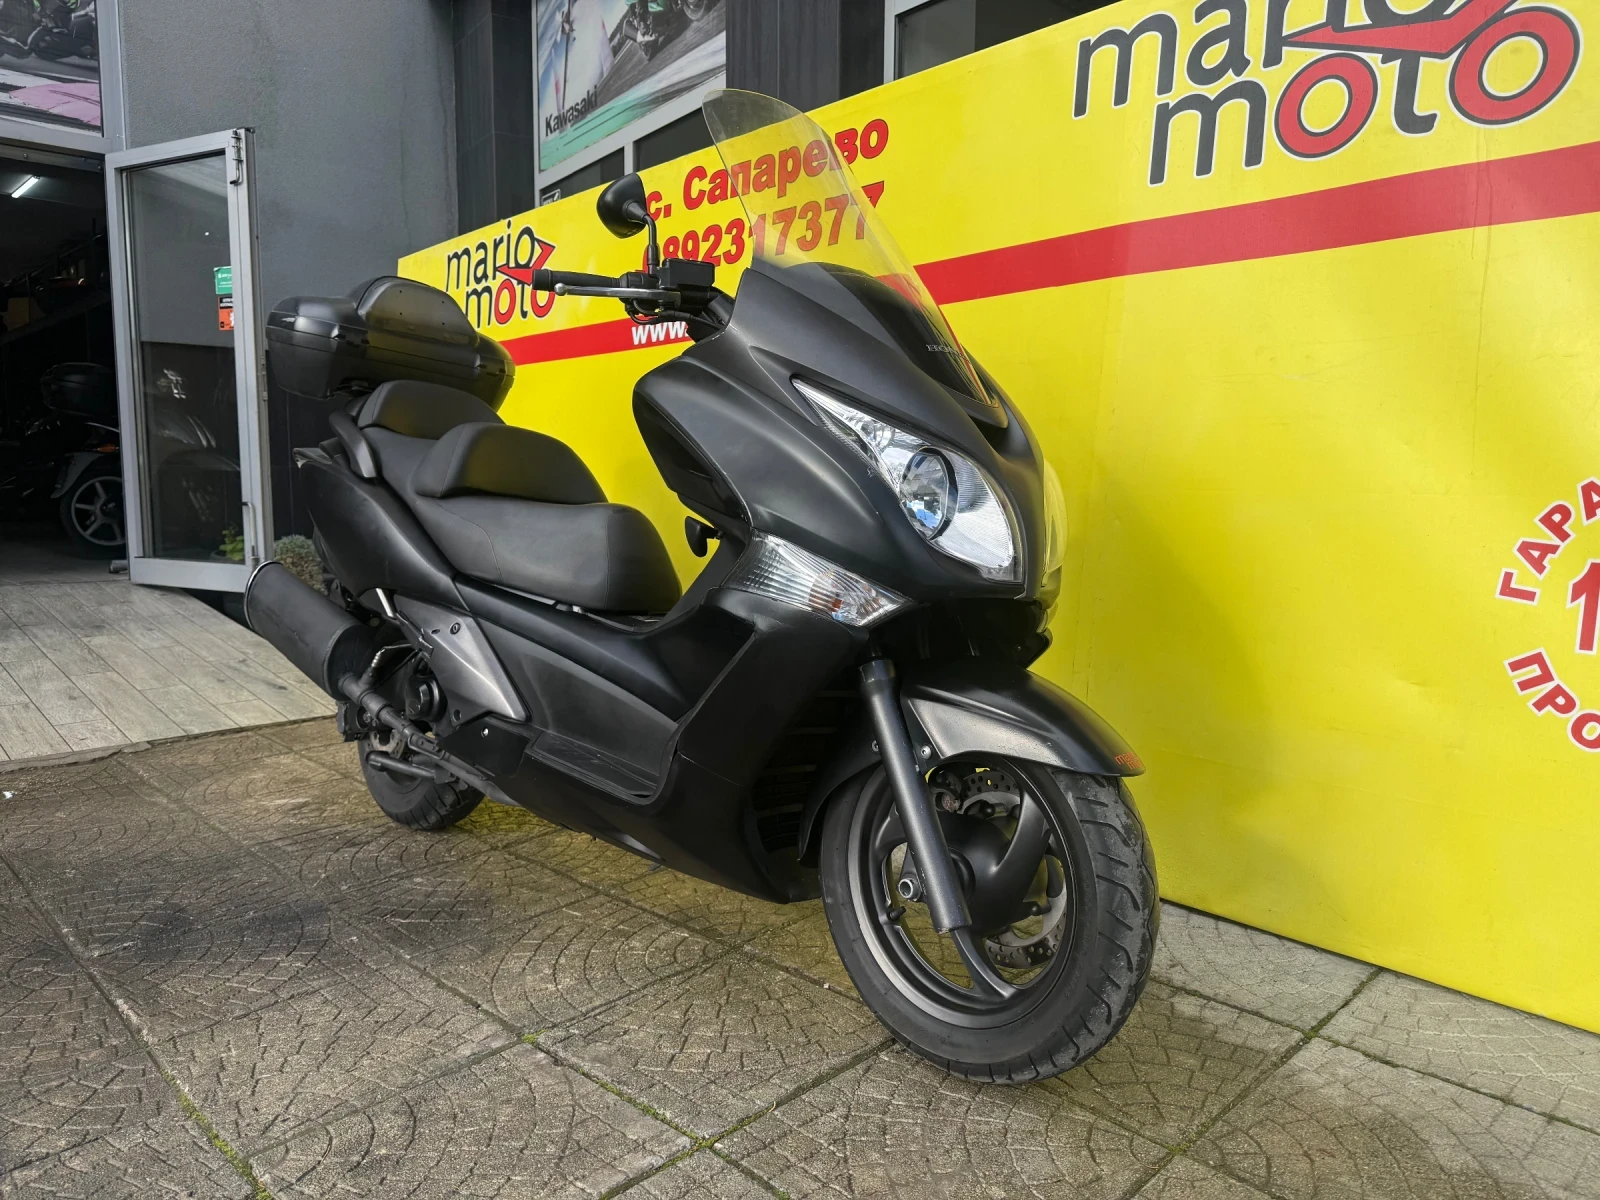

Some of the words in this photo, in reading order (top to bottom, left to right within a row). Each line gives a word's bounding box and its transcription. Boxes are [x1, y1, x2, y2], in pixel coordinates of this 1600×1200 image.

[1073, 0, 1430, 118] mar
[1149, 5, 1579, 185] moto
[545, 84, 598, 137] Kawasaki
[683, 118, 890, 210] Сапарево
[446, 219, 537, 293] mario
[642, 181, 885, 273] 892317377
[465, 278, 556, 329] moto
